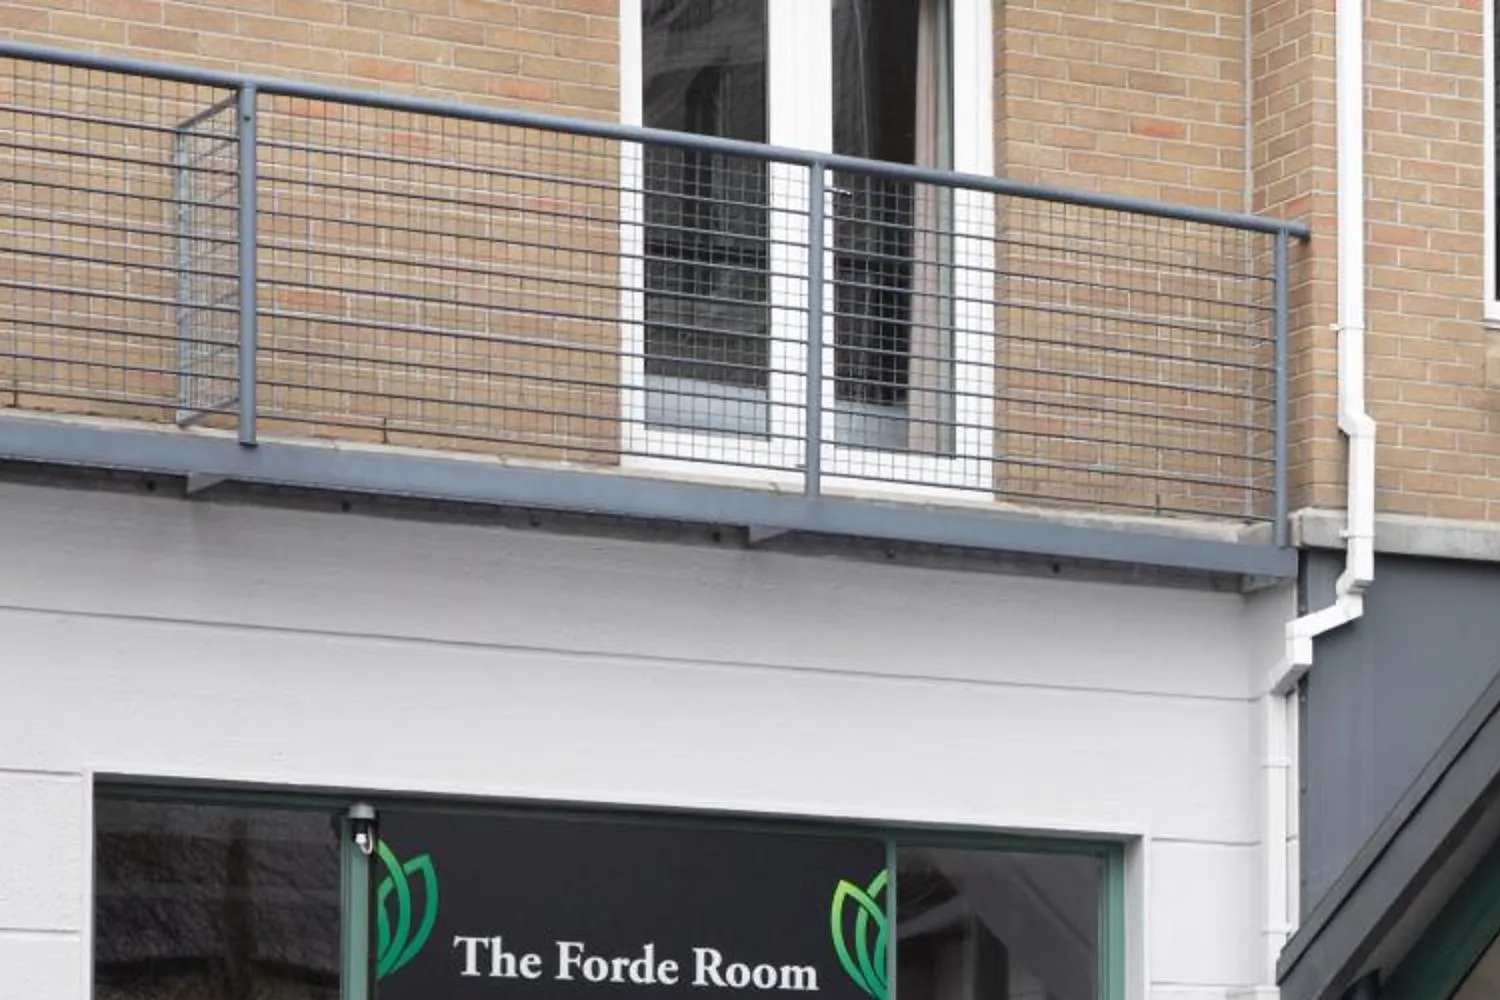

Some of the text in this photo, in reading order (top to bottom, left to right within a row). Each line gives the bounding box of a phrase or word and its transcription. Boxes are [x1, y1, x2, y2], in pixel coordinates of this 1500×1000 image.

[453, 935, 820, 991] The Forde Room
